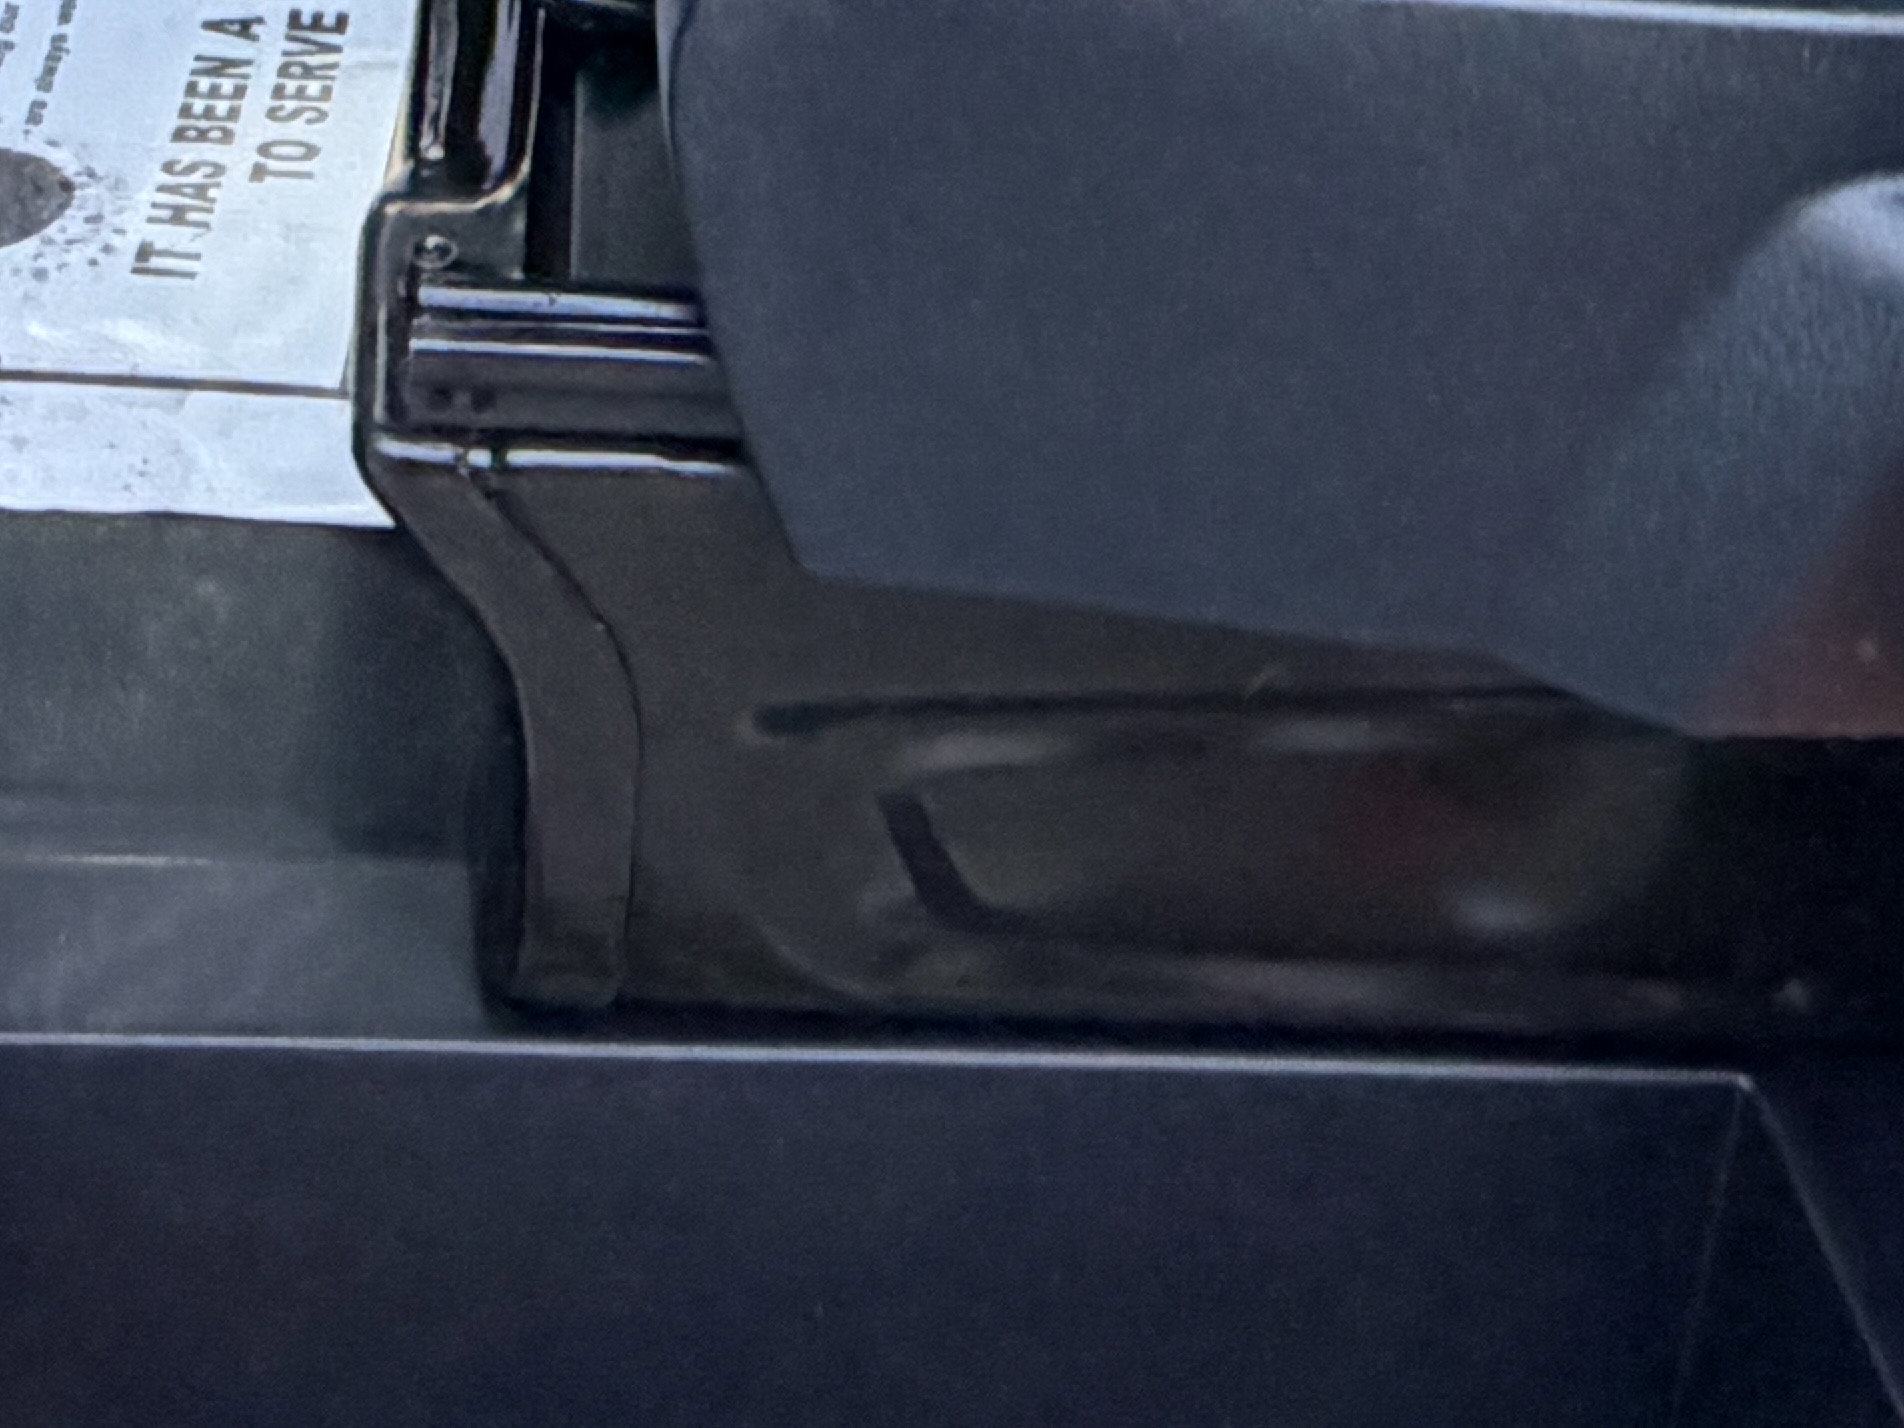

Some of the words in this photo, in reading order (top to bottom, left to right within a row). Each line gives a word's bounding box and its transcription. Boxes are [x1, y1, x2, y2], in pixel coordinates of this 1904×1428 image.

[201, 14, 266, 42] A
[34, 32, 71, 94] always
[264, 9, 349, 126] SERVE
[169, 54, 254, 146] BEEN
[249, 140, 321, 183] TO
[145, 157, 227, 232] HAS
[131, 241, 202, 280] IT
